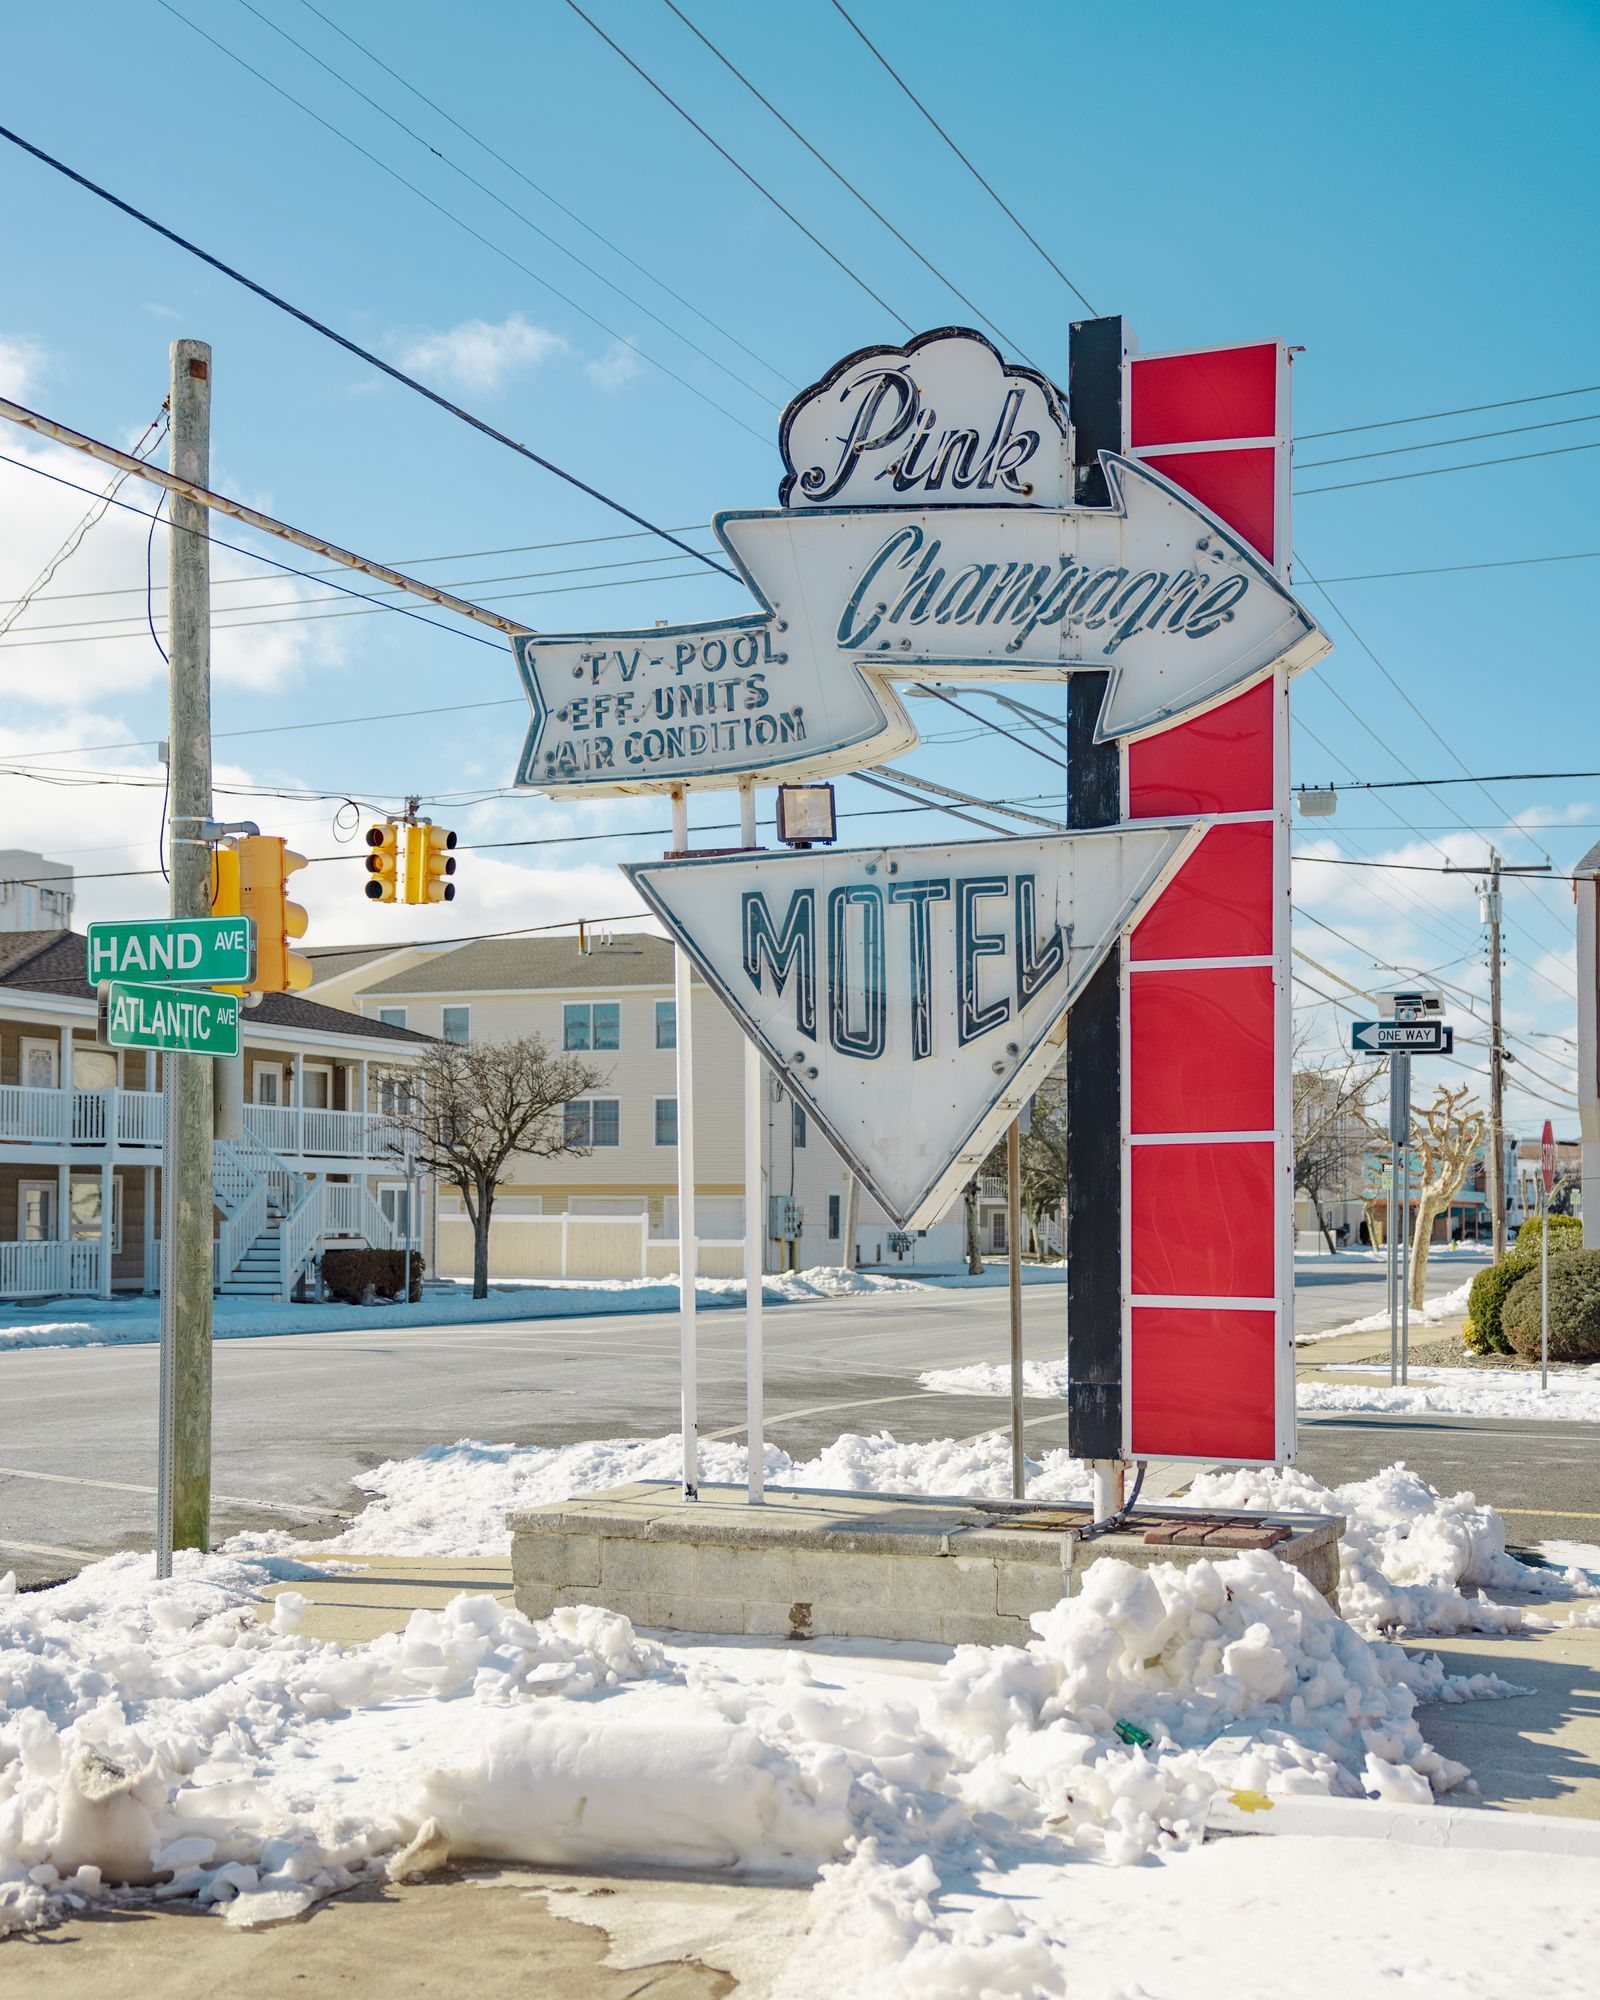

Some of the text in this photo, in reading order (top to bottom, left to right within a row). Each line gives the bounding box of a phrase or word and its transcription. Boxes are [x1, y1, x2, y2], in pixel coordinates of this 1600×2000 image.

[800, 364, 1040, 502] Pink
[837, 525, 1250, 655] Champagne
[655, 673, 770, 720] UNITS
[556, 711, 807, 772] AIR CONDITION
[93, 930, 244, 973] HAND AVE
[742, 874, 1071, 1061] MOTEL
[112, 996, 236, 1040] ATLANTIC AVE
[1378, 1030, 1432, 1041] ONE WAY
